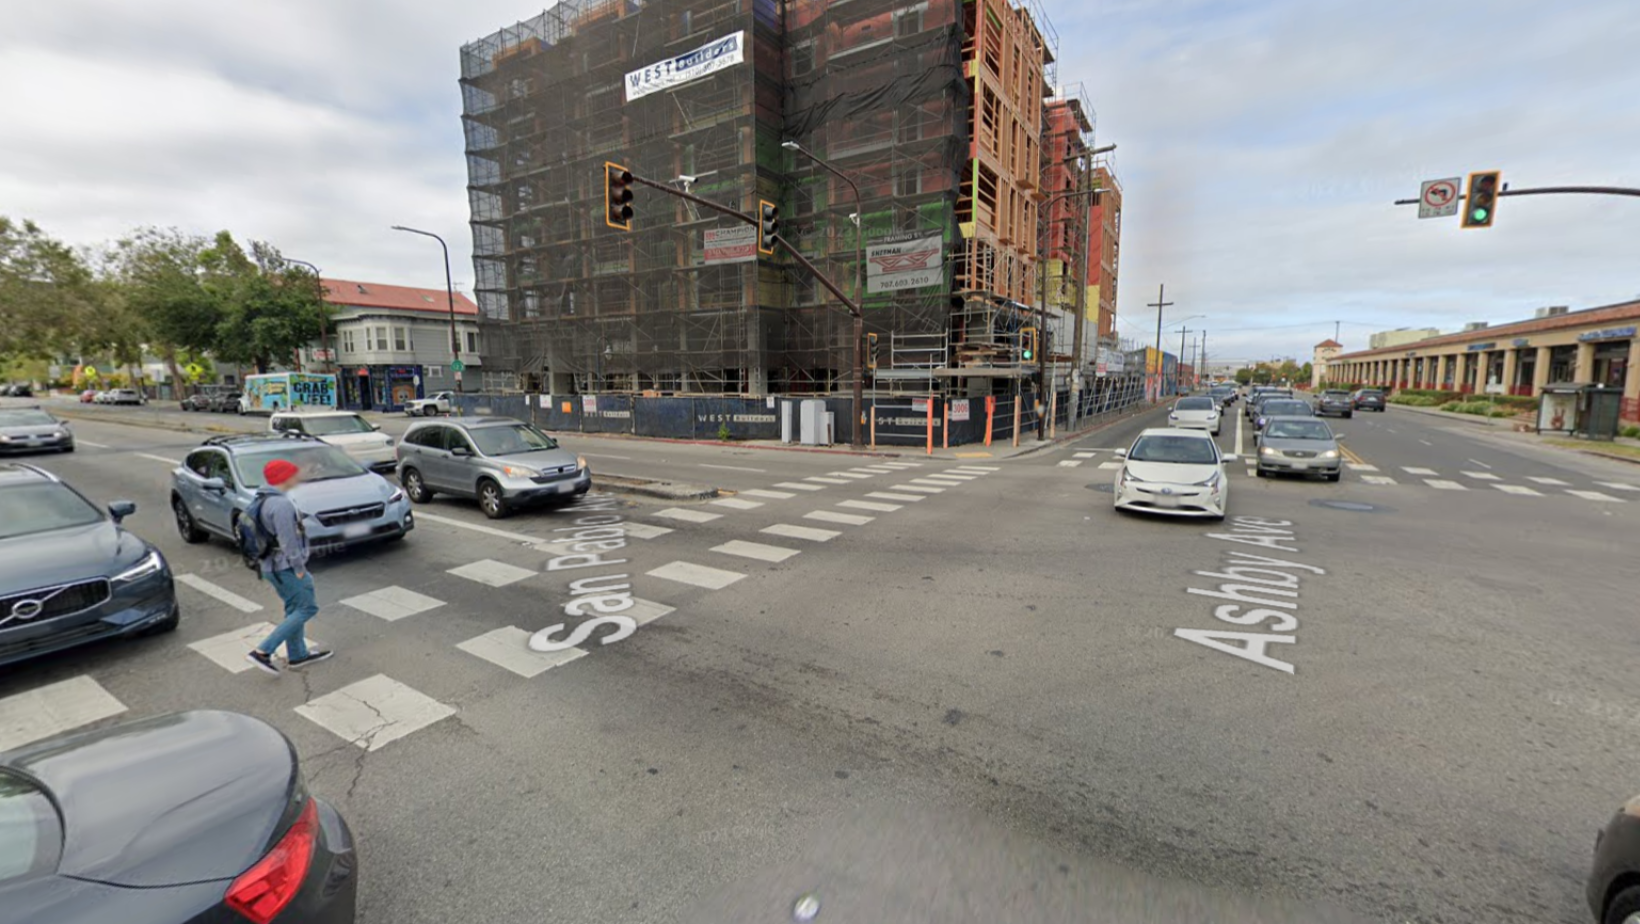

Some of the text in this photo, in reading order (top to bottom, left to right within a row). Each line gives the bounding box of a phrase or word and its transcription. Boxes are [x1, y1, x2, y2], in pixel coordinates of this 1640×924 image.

[630, 60, 672, 88] WEST
[293, 381, 329, 394] GRAB
[697, 414, 731, 423] WEST
